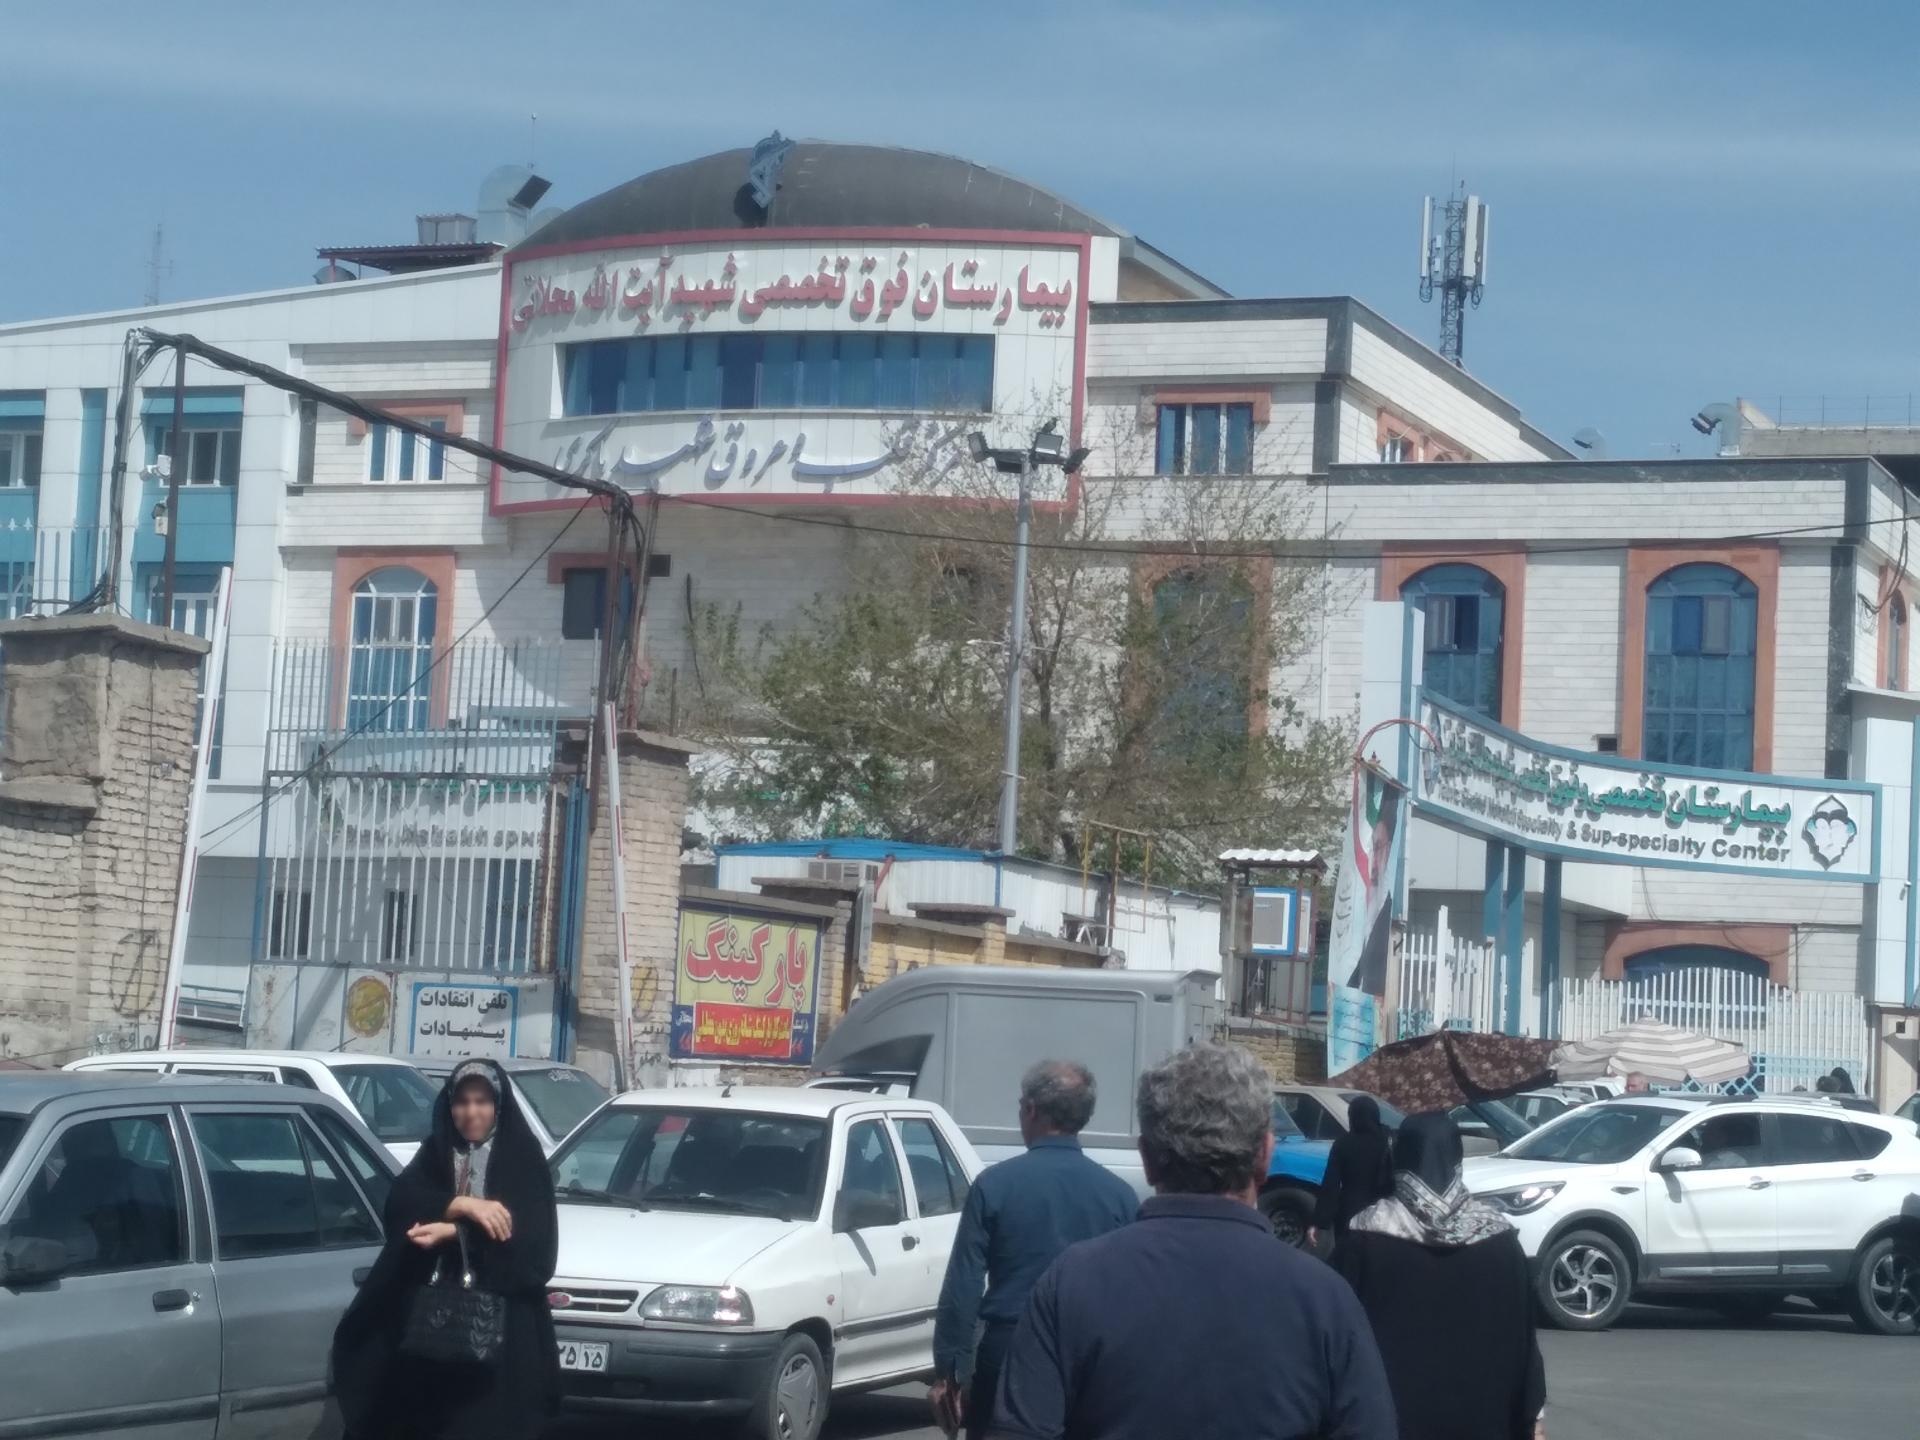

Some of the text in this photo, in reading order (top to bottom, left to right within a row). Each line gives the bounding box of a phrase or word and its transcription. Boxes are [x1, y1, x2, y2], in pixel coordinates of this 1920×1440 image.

[668, 252, 737, 324] شهید
[738, 254, 847, 322] تخصصی
[850, 250, 910, 322] فوق
[914, 257, 1073, 329] بیمارستان
[1587, 772, 1667, 822] تخصصی
[1664, 784, 1792, 846] بیمارستان
[1565, 820, 1577, 840] &
[1580, 823, 1706, 859] Sup-specialty
[1711, 838, 1791, 863] Center
[419, 1019, 506, 1045] پیشنهادات
[420, 989, 509, 1014] تلفن انتقادات
